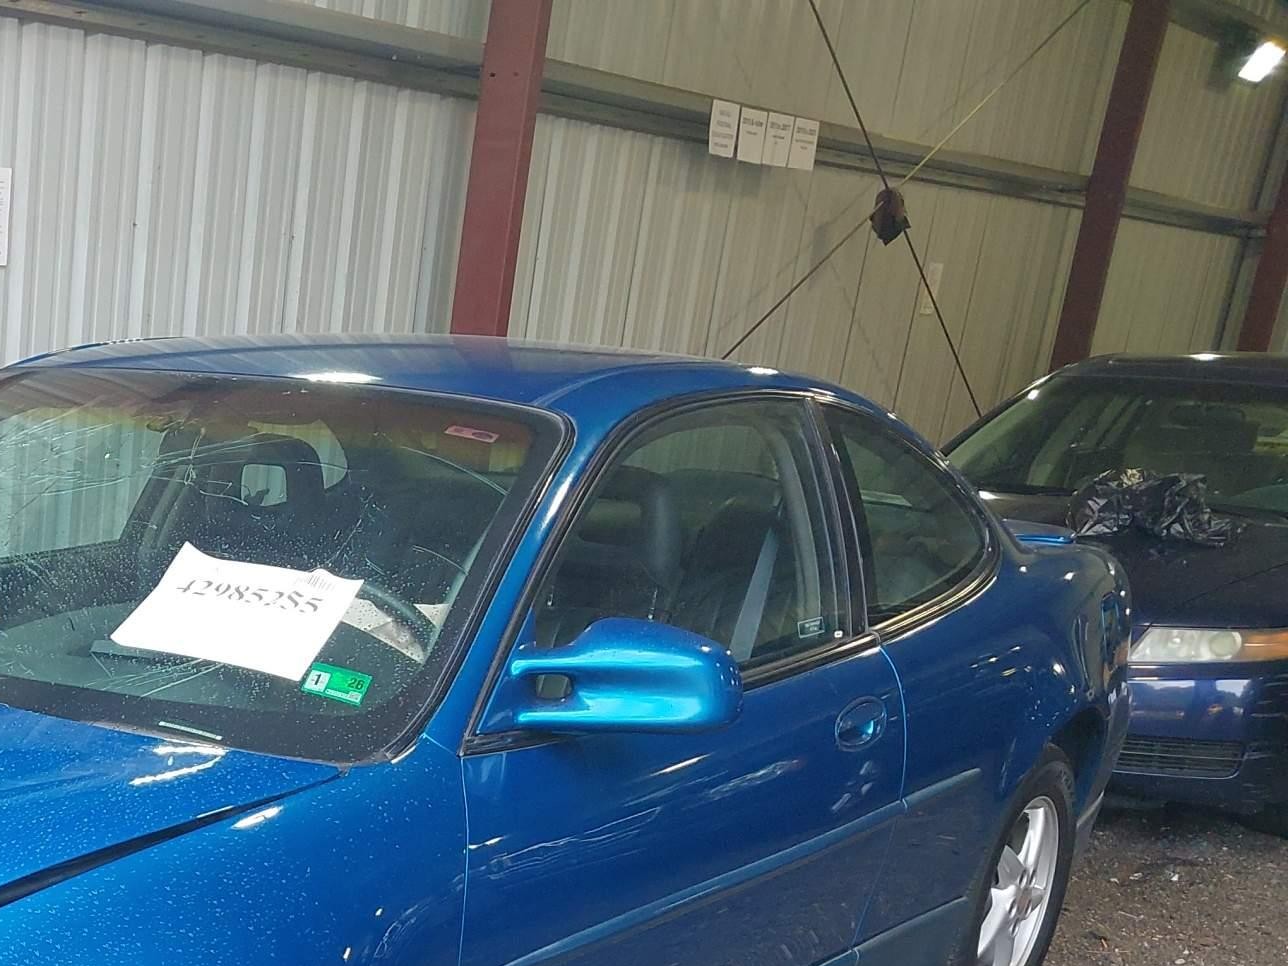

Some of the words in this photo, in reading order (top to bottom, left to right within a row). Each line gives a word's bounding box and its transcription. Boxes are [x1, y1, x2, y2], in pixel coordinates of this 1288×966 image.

[175, 579, 324, 613] 42985255
[314, 673, 322, 686] 1
[347, 677, 365, 690] 26
